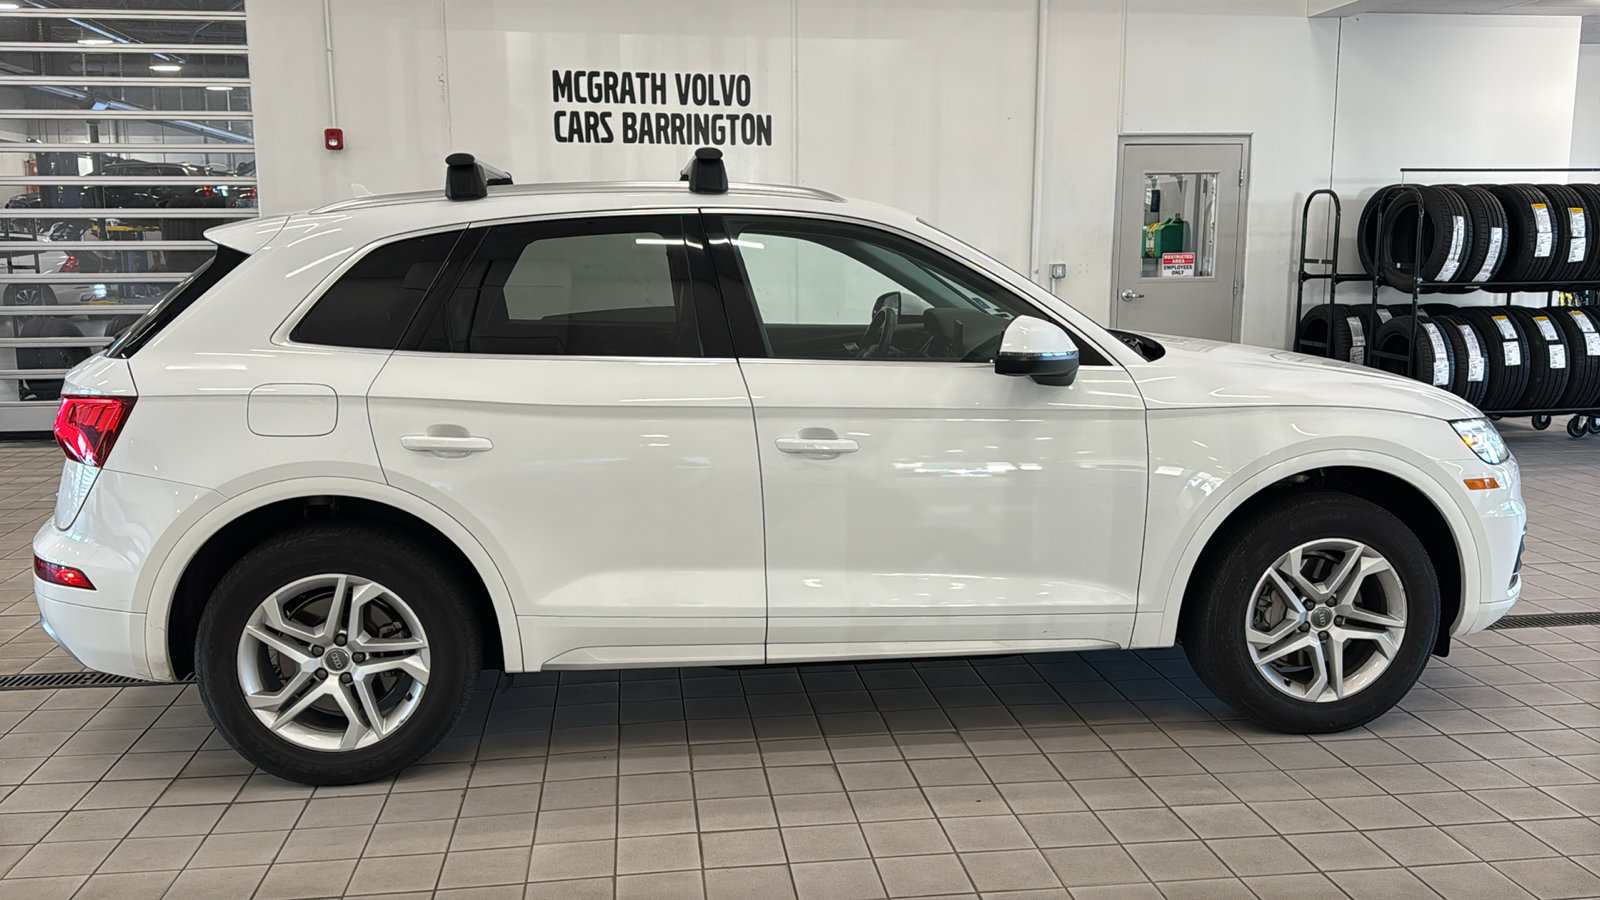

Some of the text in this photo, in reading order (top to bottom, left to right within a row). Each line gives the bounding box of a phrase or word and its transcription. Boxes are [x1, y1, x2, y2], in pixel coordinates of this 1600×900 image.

[552, 70, 751, 106] MCGRATH VOLVO
[554, 110, 772, 146] CARS BARRINGTON
